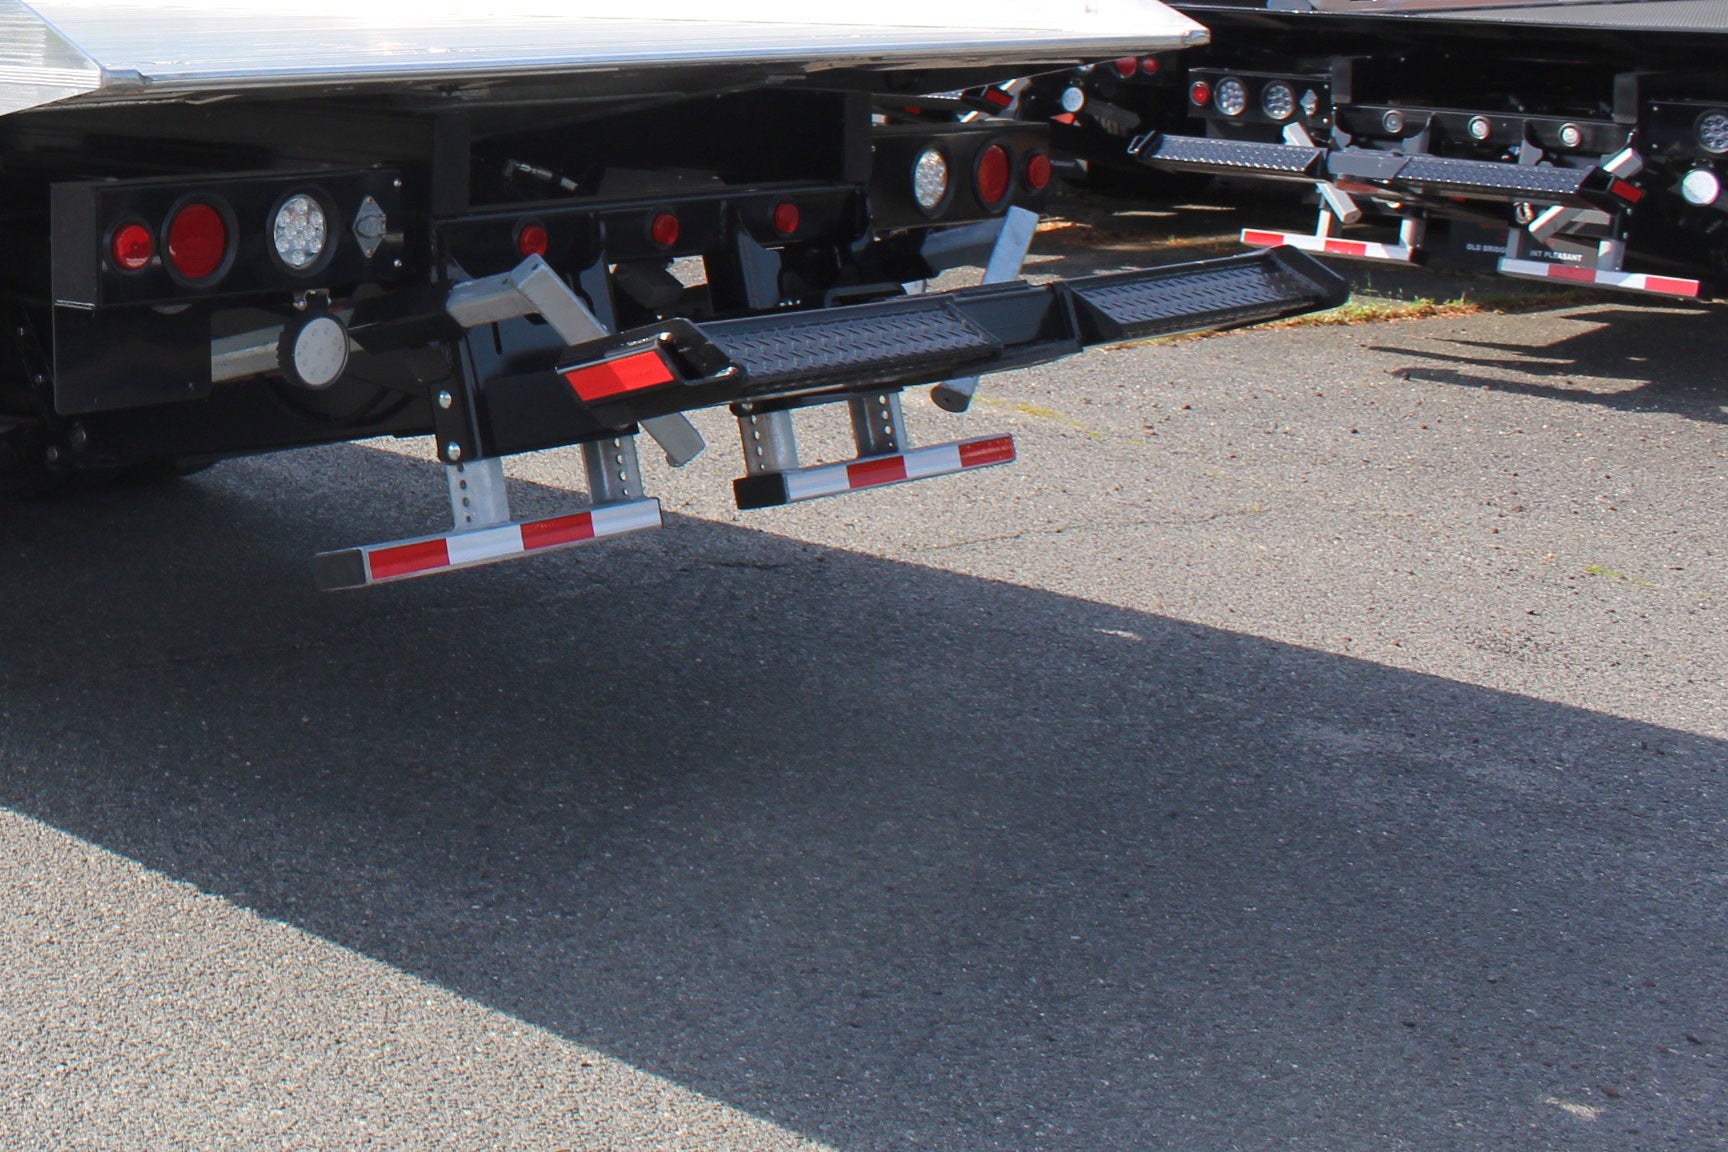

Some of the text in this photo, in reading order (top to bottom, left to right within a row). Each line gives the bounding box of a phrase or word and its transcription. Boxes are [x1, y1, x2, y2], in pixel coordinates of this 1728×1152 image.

[1466, 243, 1481, 251] OLD
[1482, 244, 1507, 254] BRIDG
[1544, 250, 1583, 262] PLEASANT
